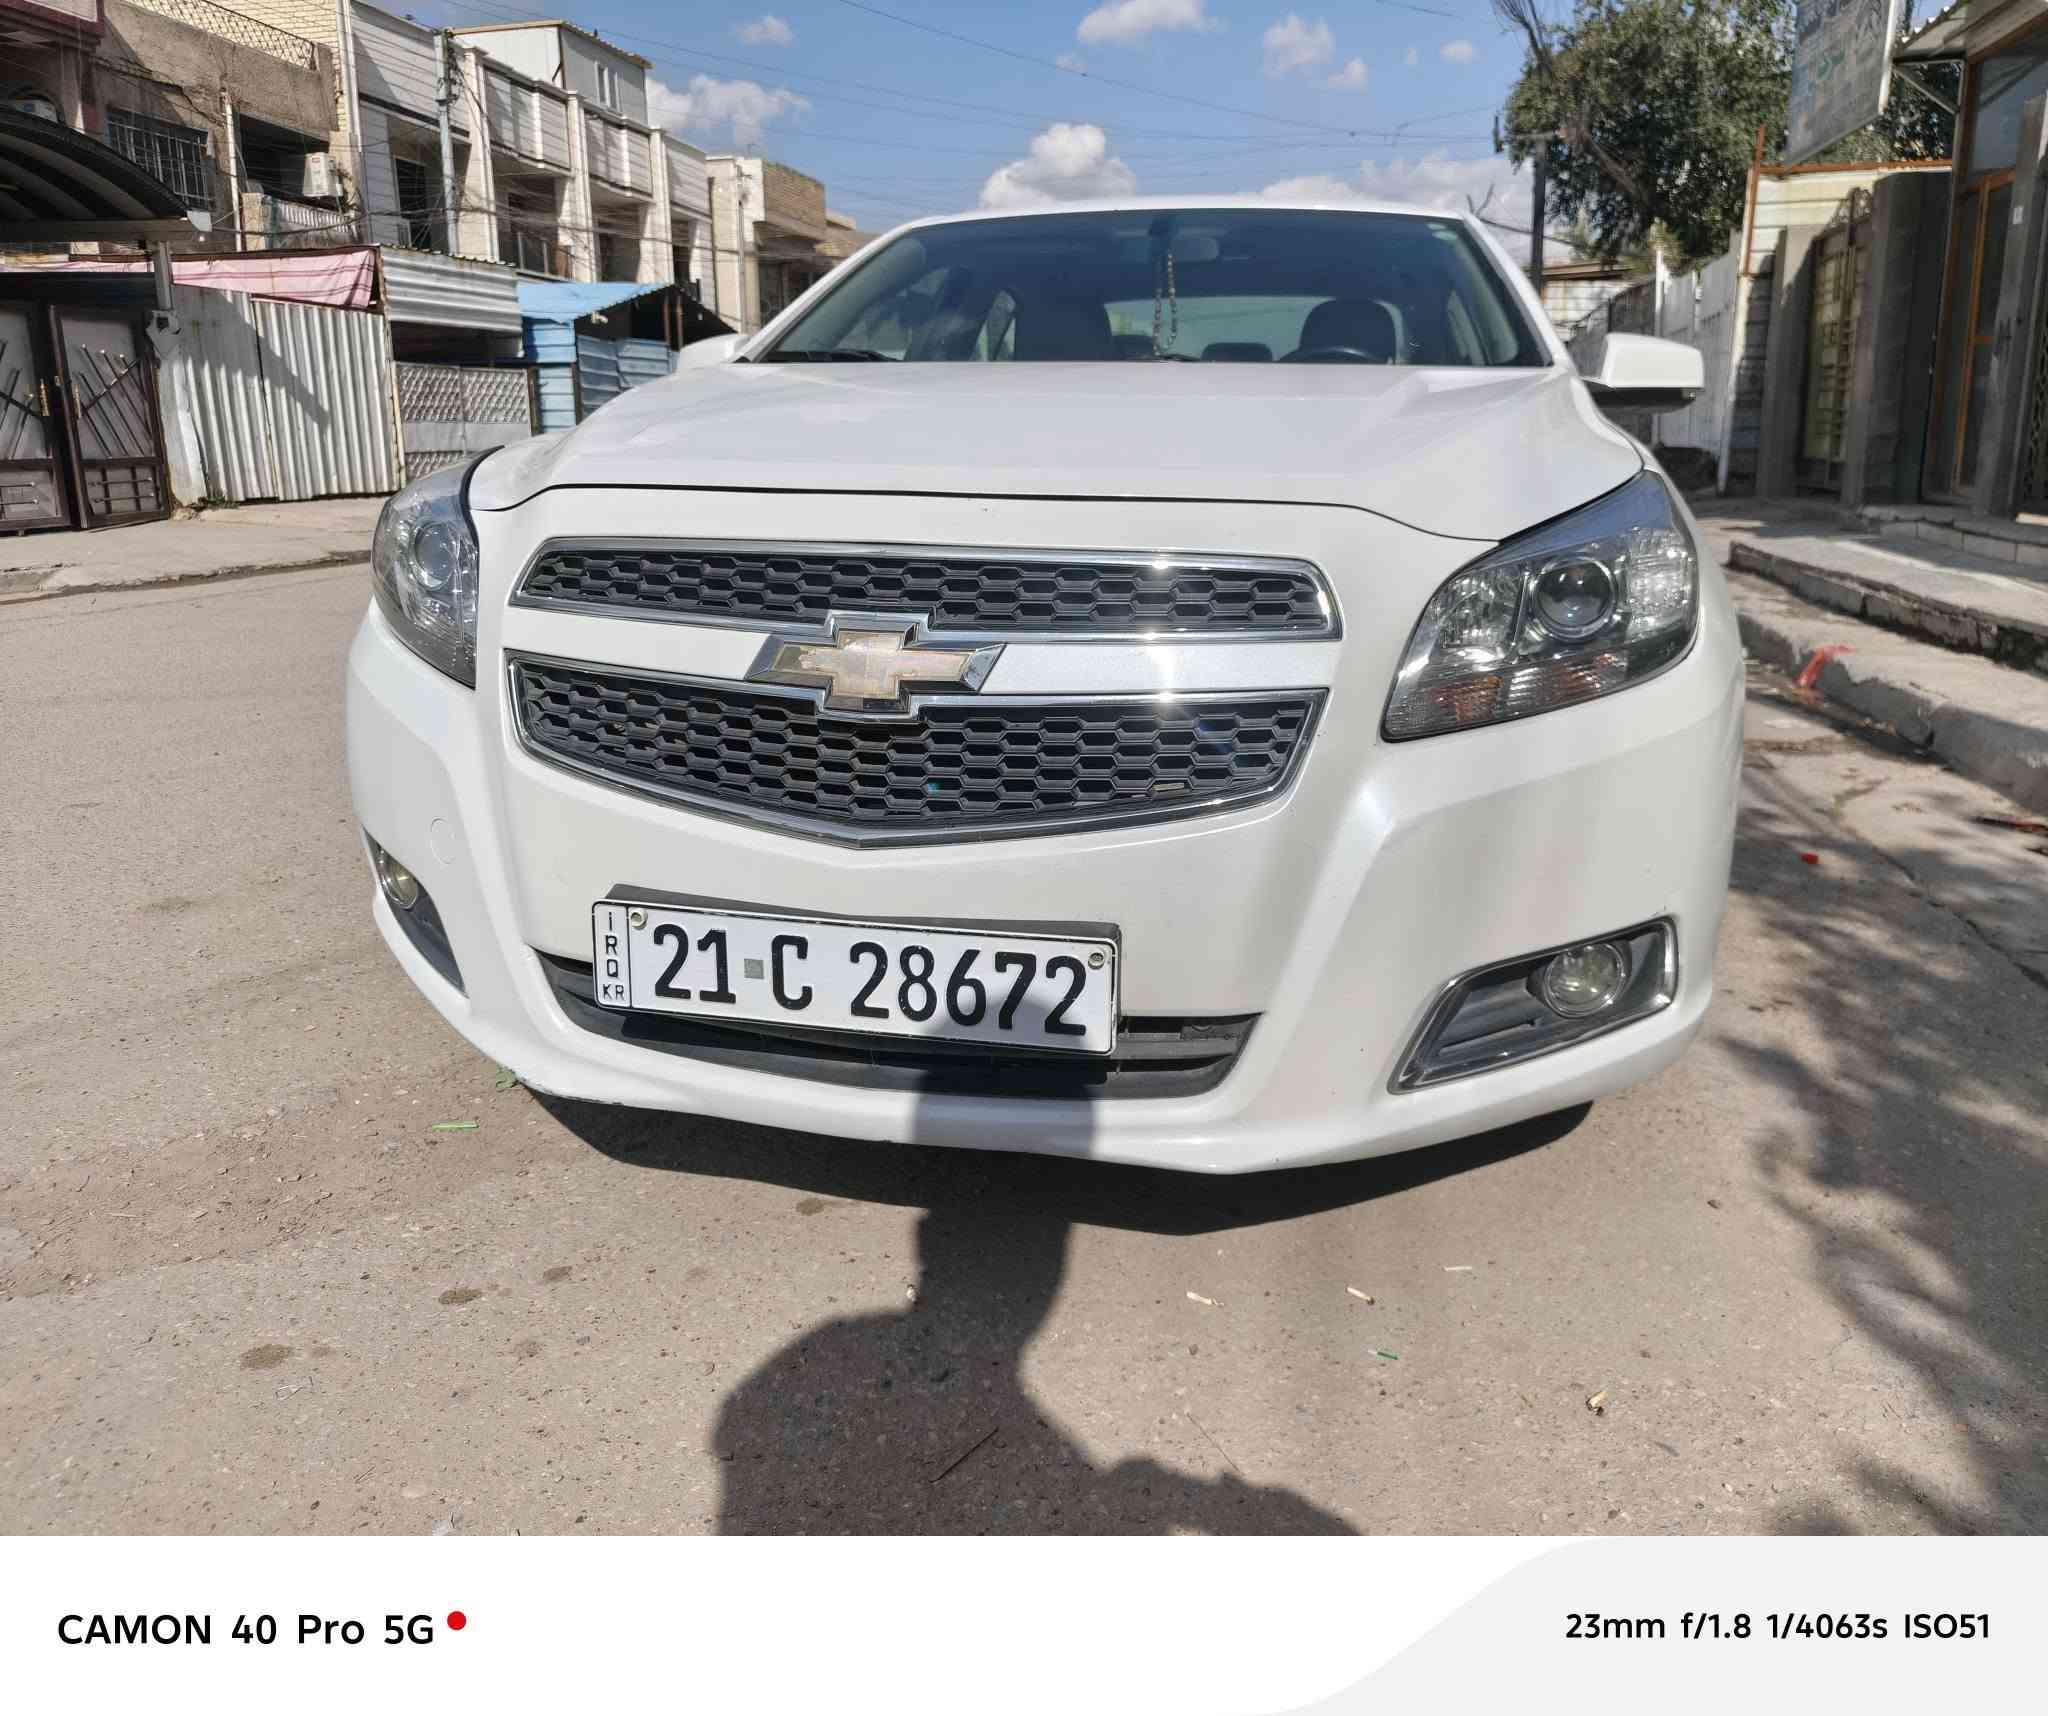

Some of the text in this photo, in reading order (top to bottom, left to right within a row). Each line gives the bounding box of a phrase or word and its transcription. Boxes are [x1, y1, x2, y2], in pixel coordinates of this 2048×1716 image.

[602, 983, 626, 1001] KR
[653, 923, 1087, 1037] 21 C 28672
